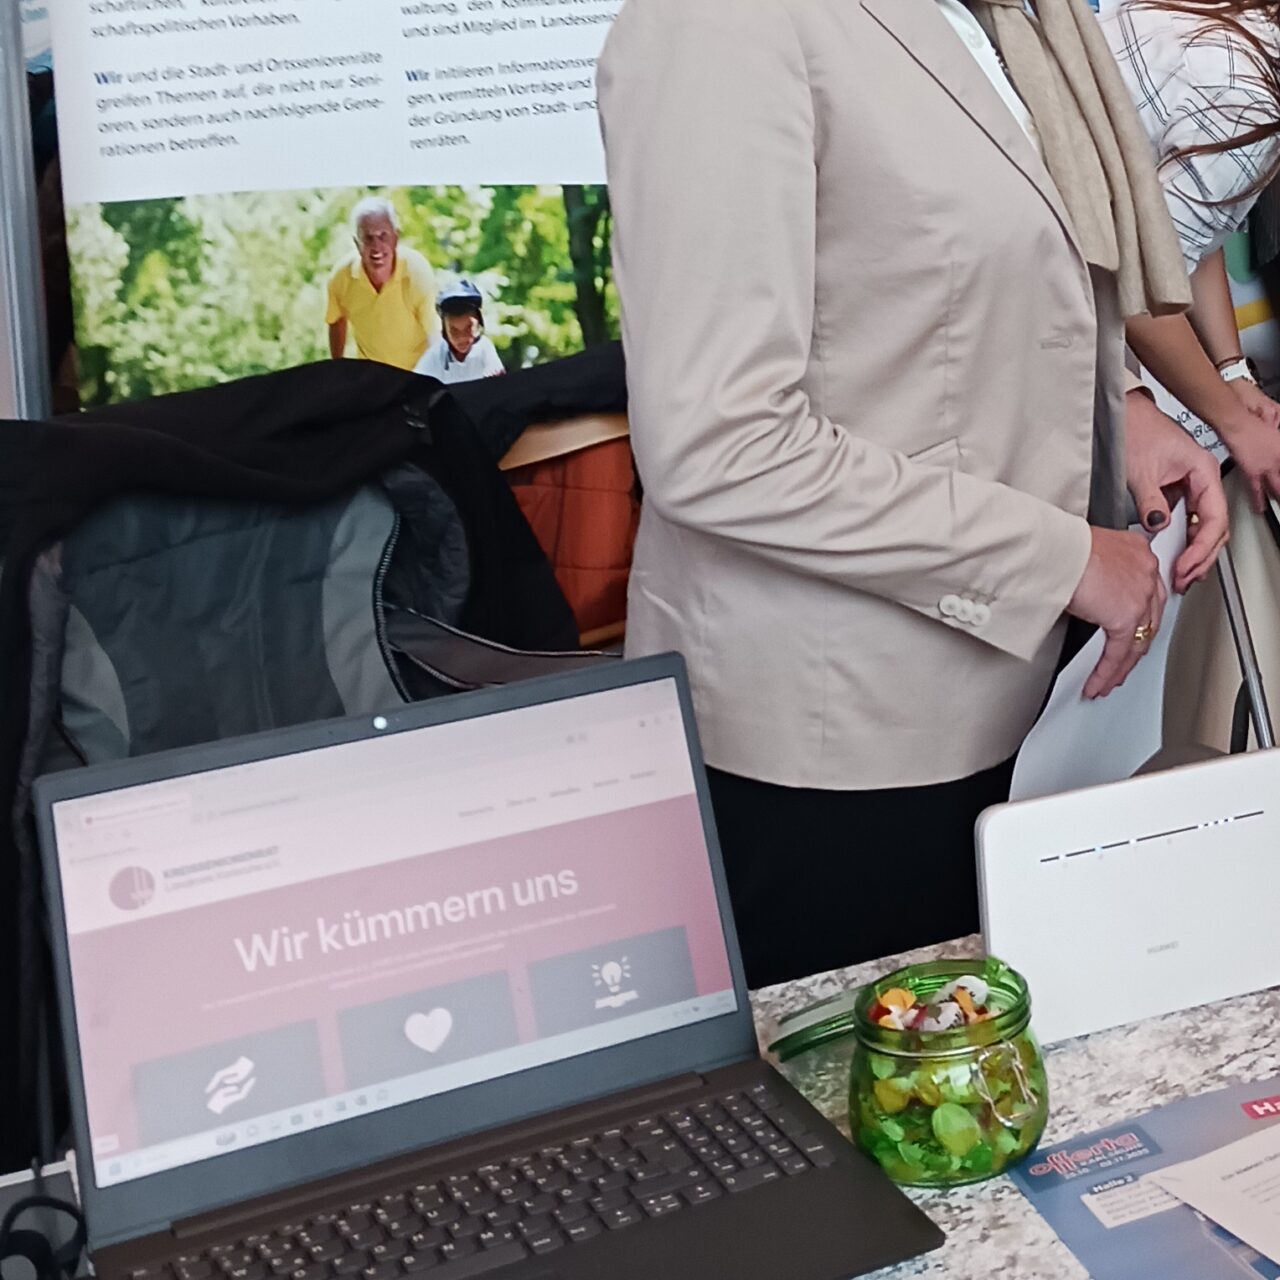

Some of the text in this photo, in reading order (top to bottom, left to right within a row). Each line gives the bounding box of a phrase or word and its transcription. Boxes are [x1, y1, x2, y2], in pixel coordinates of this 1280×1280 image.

[402, 24, 430, 38] und
[94, 71, 123, 85] Wir
[127, 69, 158, 83] und
[234, 61, 263, 75] und
[405, 69, 430, 82] Wir
[567, 76, 592, 90] und
[407, 113, 431, 128] der
[234, 869, 579, 972] Wir kümmern uns
